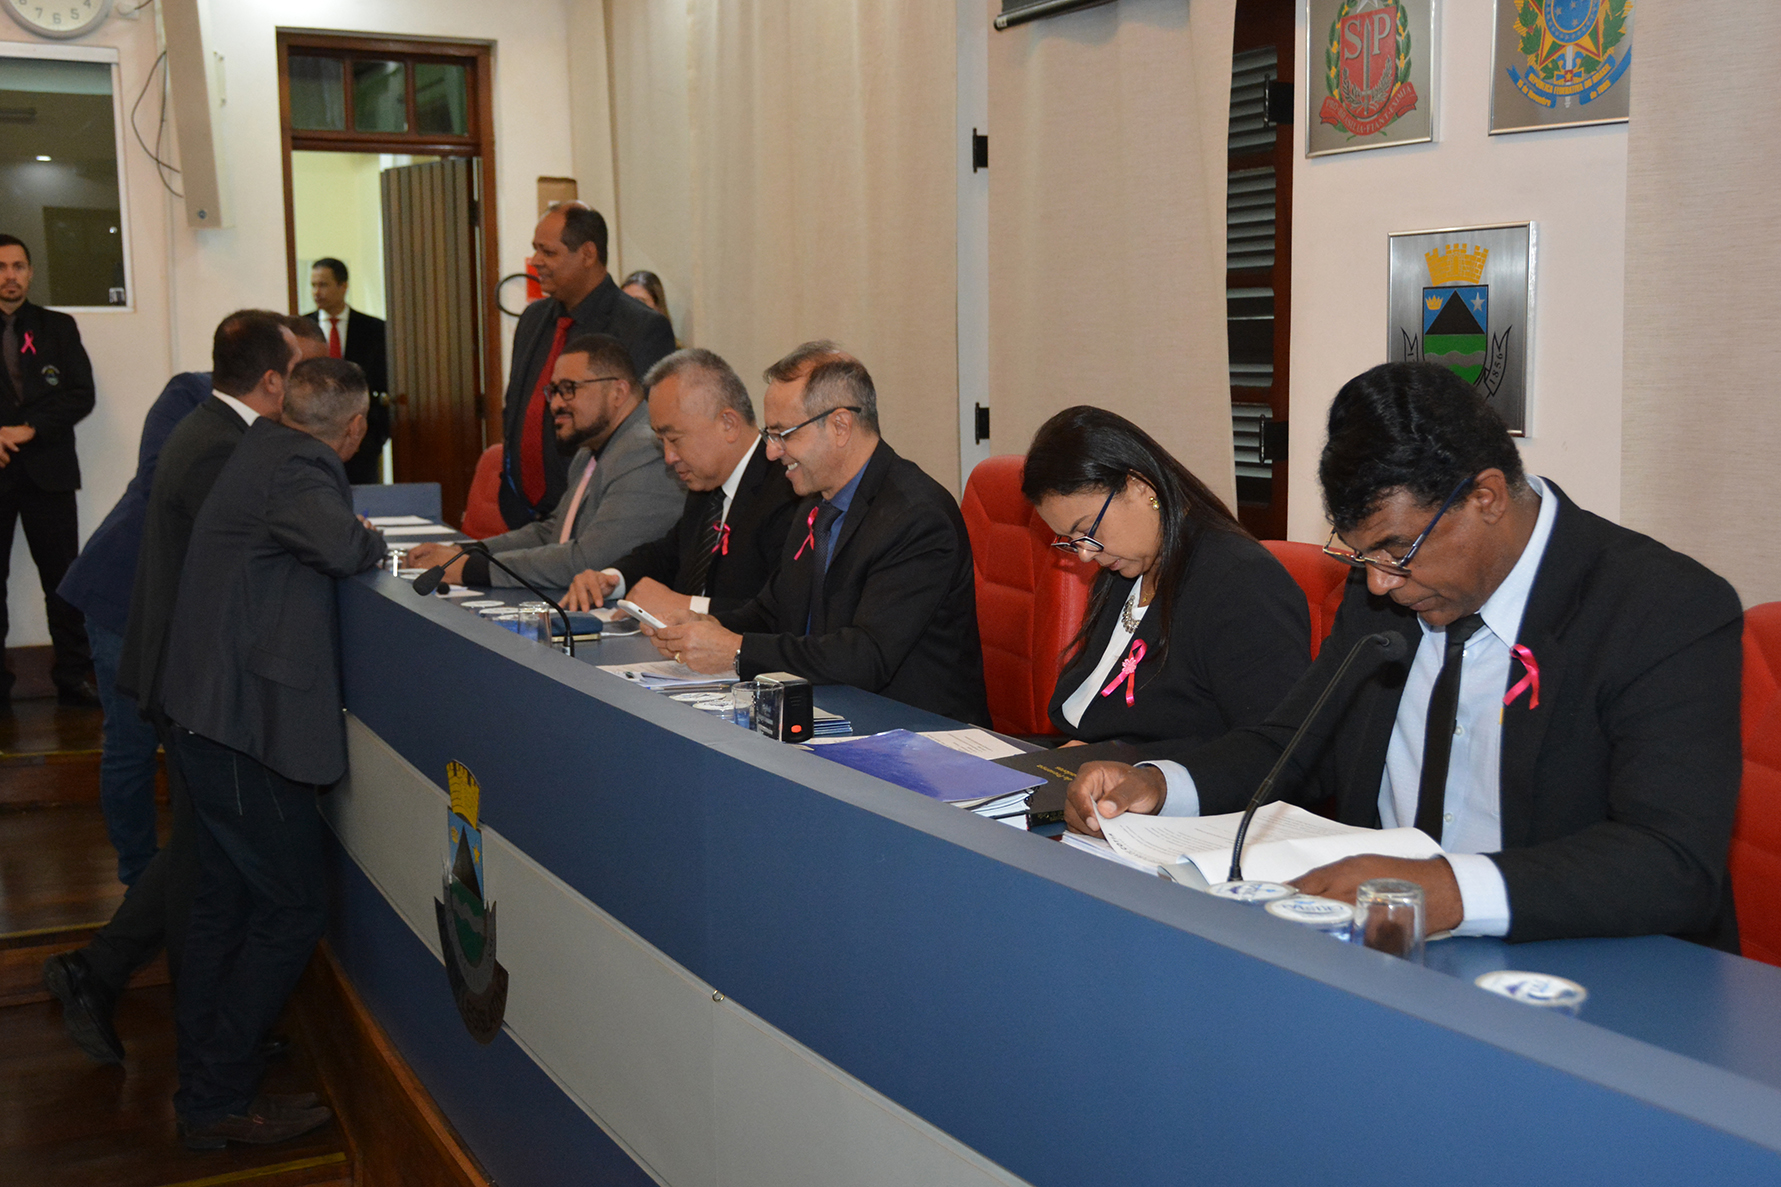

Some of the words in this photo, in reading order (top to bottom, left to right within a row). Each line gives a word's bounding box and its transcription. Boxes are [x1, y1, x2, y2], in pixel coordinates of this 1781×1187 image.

[35, 7, 43, 18] 7
[53, 12, 61, 24] 6
[70, 8, 79, 20] 5
[1489, 353, 1503, 386] 1856
